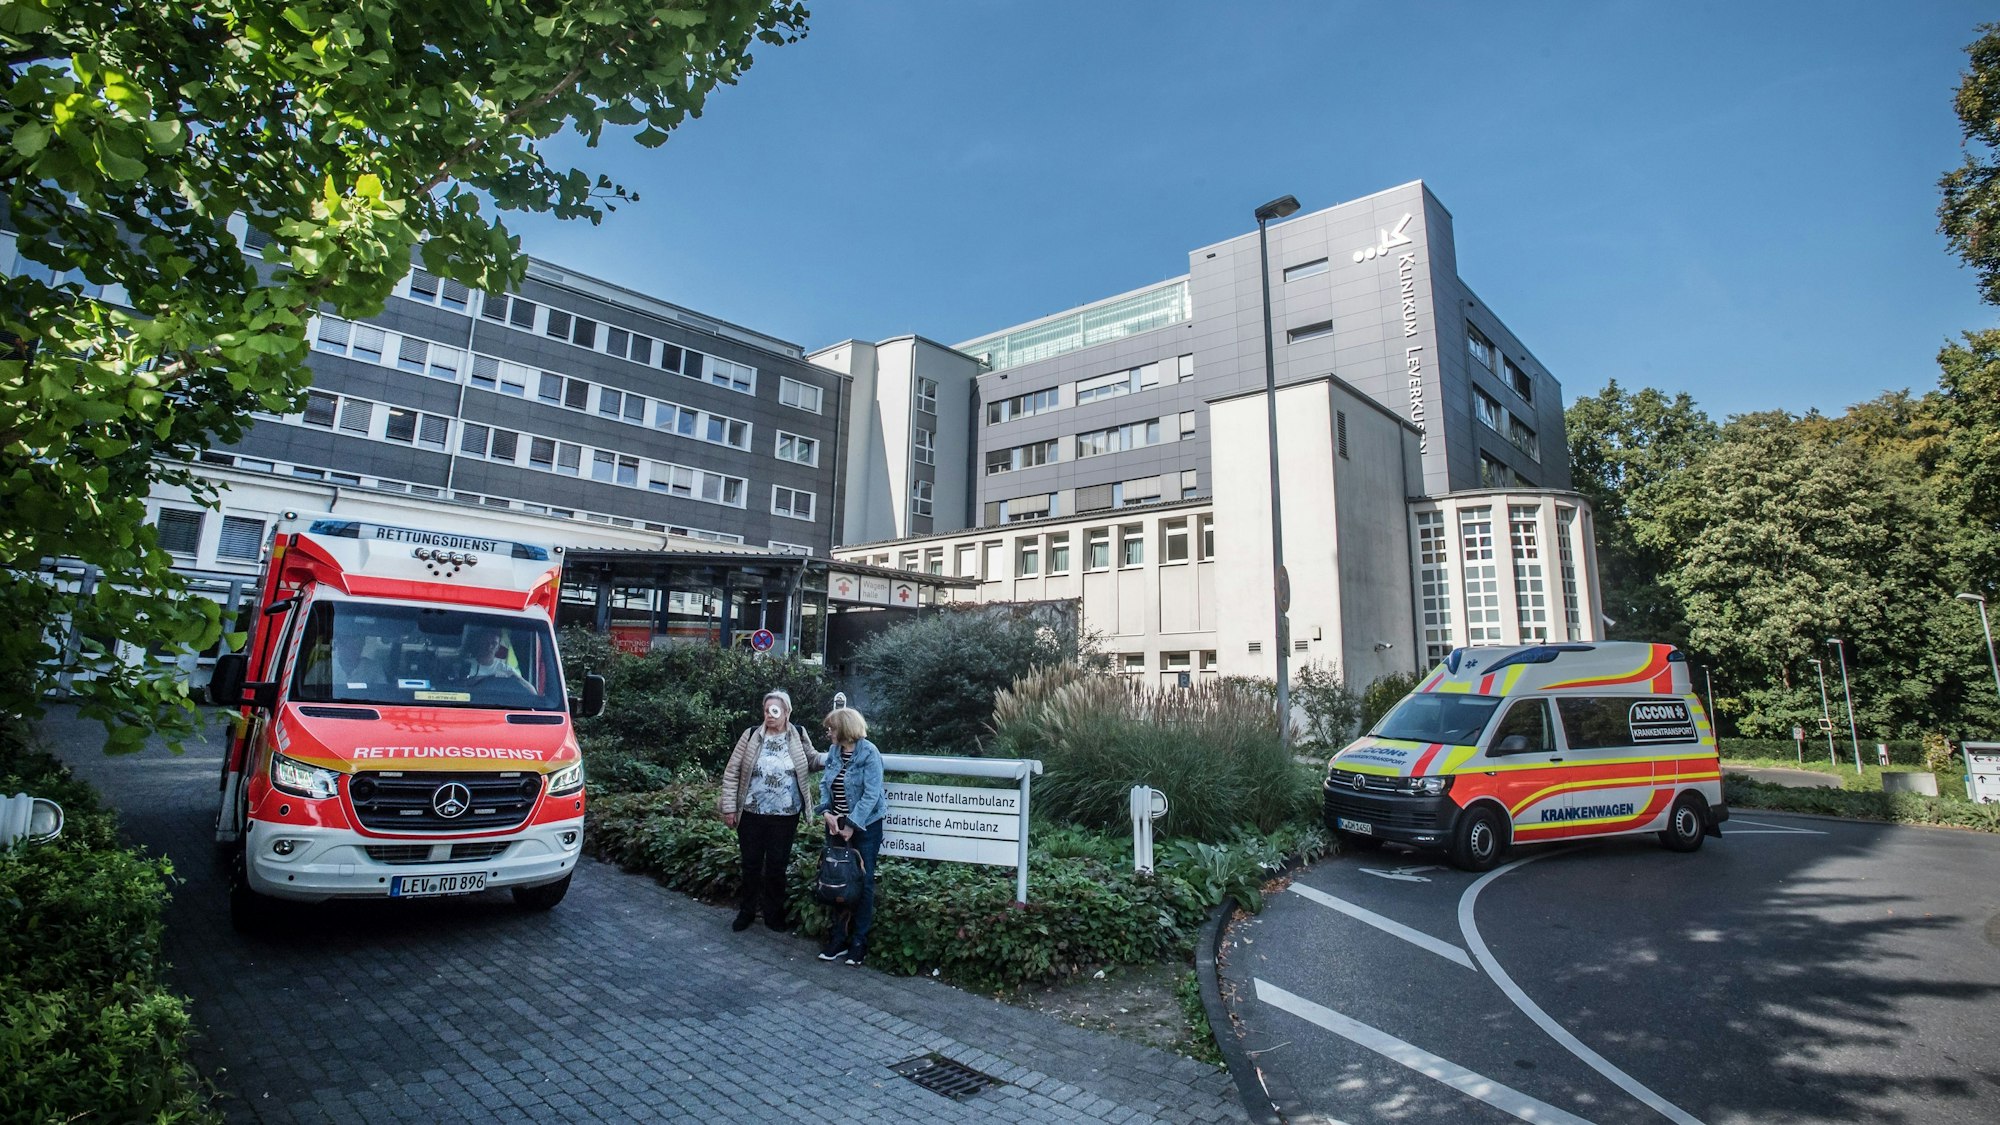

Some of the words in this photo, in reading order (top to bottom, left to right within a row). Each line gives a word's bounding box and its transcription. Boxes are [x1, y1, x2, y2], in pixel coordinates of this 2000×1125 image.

[1398, 252, 1417, 338] KLINIKUM
[376, 527, 498, 552] RETTUNGSDIENST
[863, 590, 879, 598] halle
[1635, 704, 1676, 720] ACCON
[1633, 726, 1693, 737] KRANKENTRANSPORT
[353, 747, 543, 760] RETTUNGSDIENST
[926, 791, 1015, 808] Notfallambulanz
[1541, 803, 1634, 822] KRANKENWAGEN
[944, 818, 999, 833] Ambulanz
[401, 878, 430, 893] LEV
[439, 877, 457, 891] RD
[460, 875, 484, 890] 896
